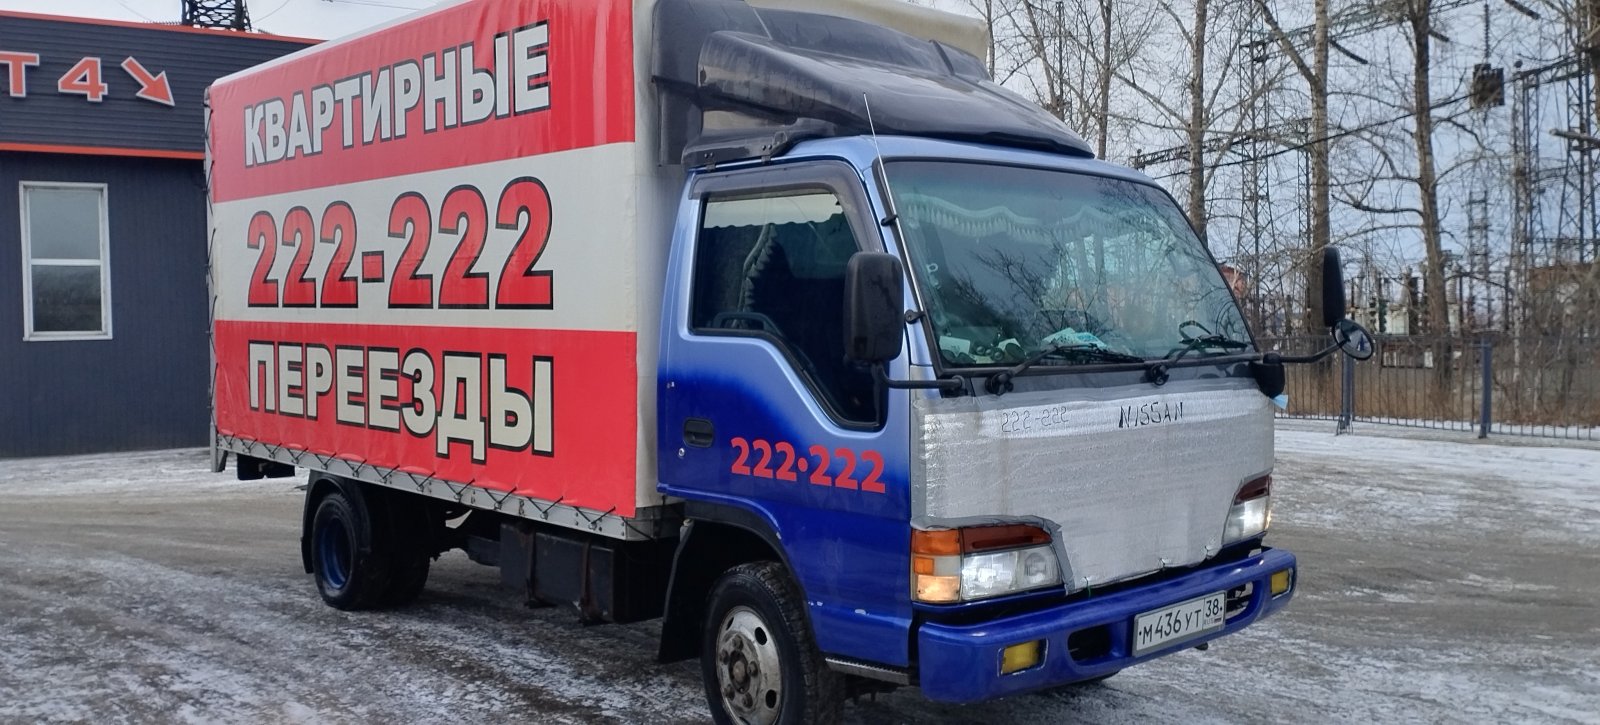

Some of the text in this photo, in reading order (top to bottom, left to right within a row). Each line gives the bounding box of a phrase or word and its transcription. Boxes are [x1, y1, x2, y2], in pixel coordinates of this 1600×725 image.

[58, 57, 108, 102] 4
[244, 19, 551, 168] КВАРТИРНЫЕ
[247, 176, 554, 310] 222-222
[248, 340, 554, 464] ПЕРЕЕЗДЫ
[1002, 406, 1069, 432] 222-222
[1119, 401, 1183, 428] NISSAN
